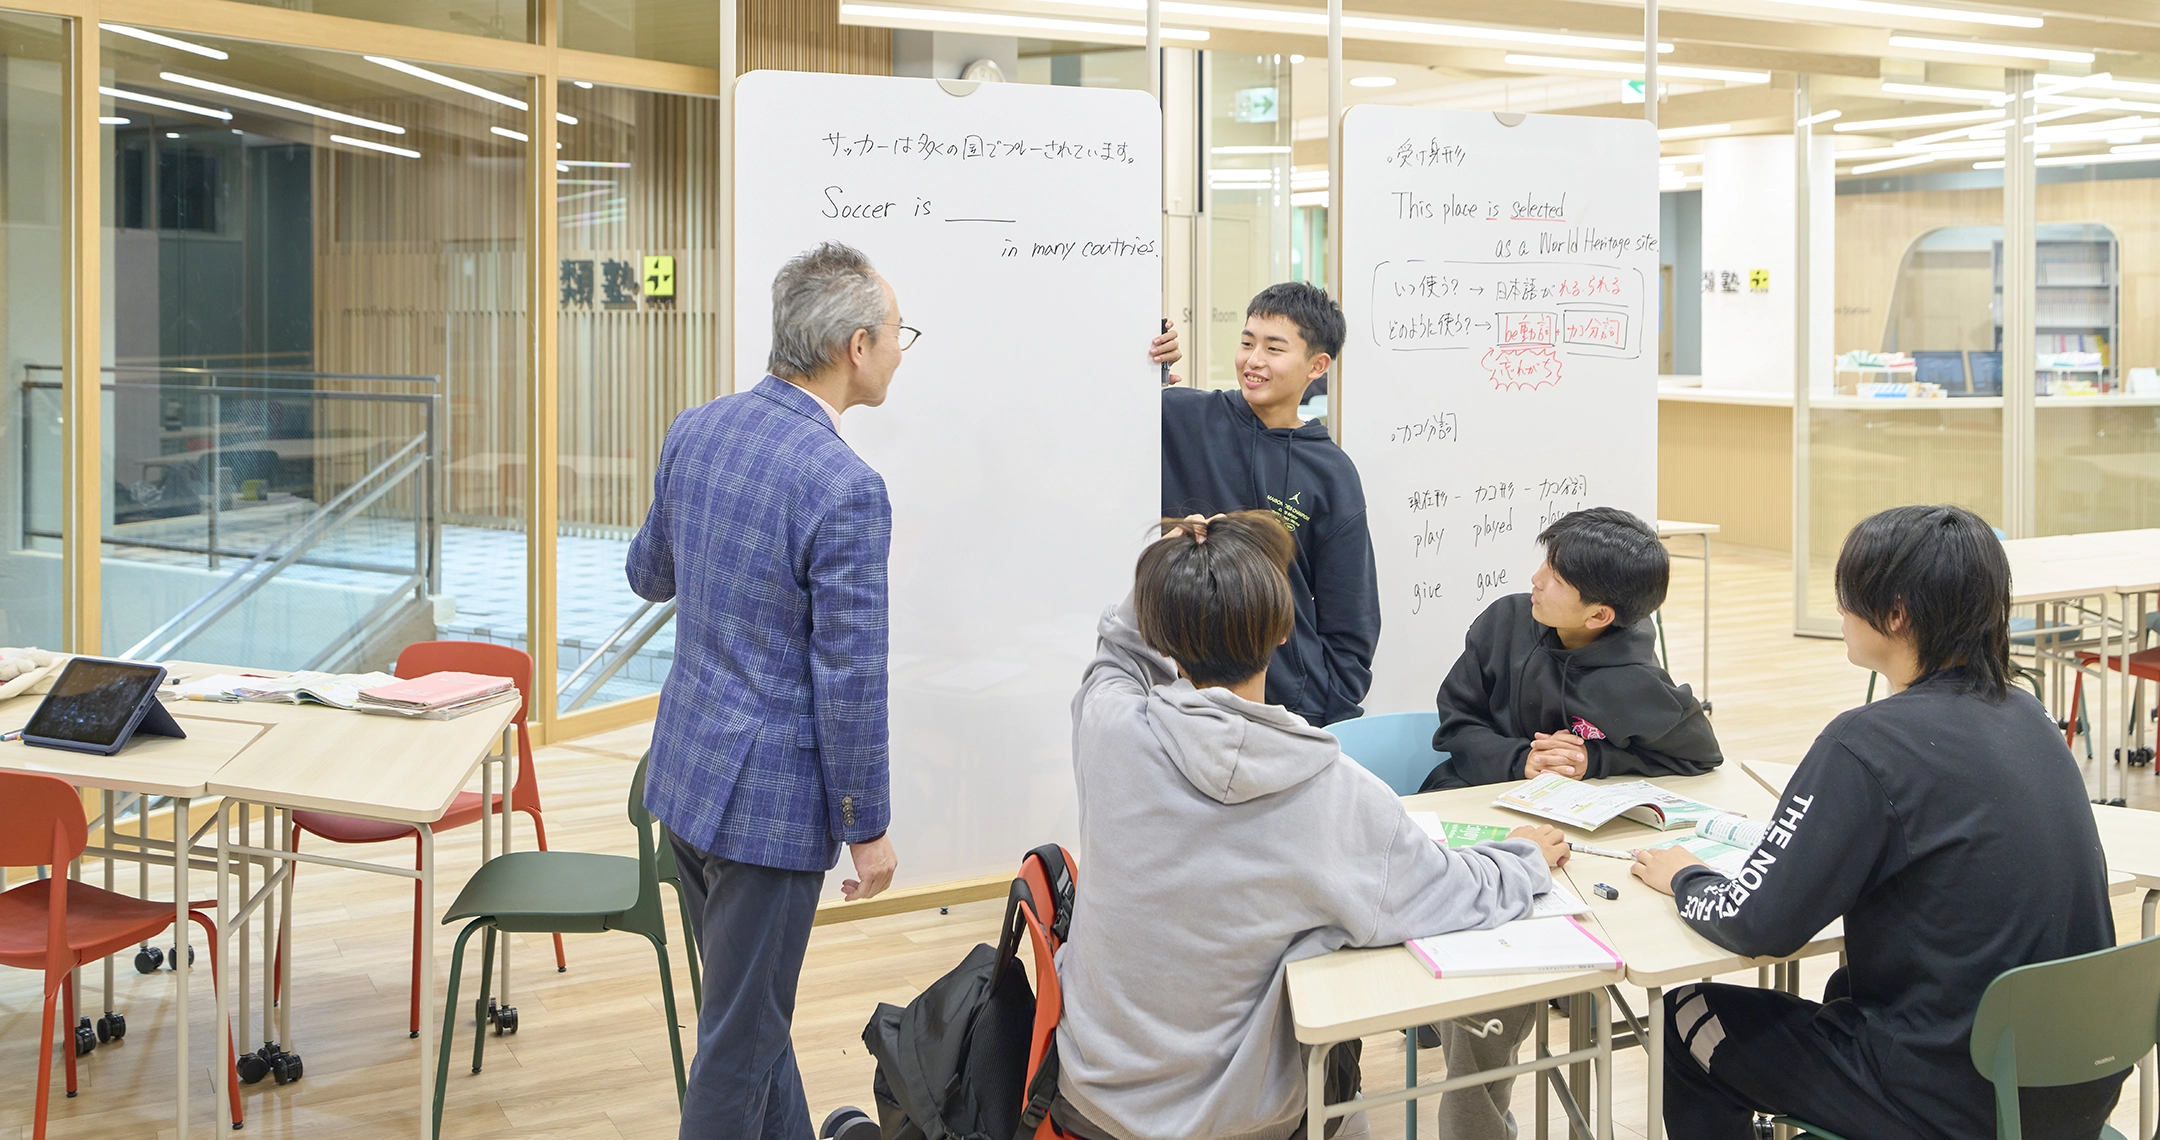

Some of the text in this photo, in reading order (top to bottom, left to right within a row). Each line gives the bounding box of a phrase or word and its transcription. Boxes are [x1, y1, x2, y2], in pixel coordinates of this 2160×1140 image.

[821, 185, 932, 219] Soccer is
[1391, 191, 1567, 225] This place is selected
[1000, 238, 1018, 258] in
[1031, 241, 1077, 262] many
[1495, 226, 1660, 259] as a World Heritage site.
[1212, 307, 1238, 322] Room
[1413, 500, 1580, 558] play played pla
[1411, 568, 1509, 616] give gave
[1767, 794, 1815, 850] THE
[1680, 895, 1716, 921] FACE
